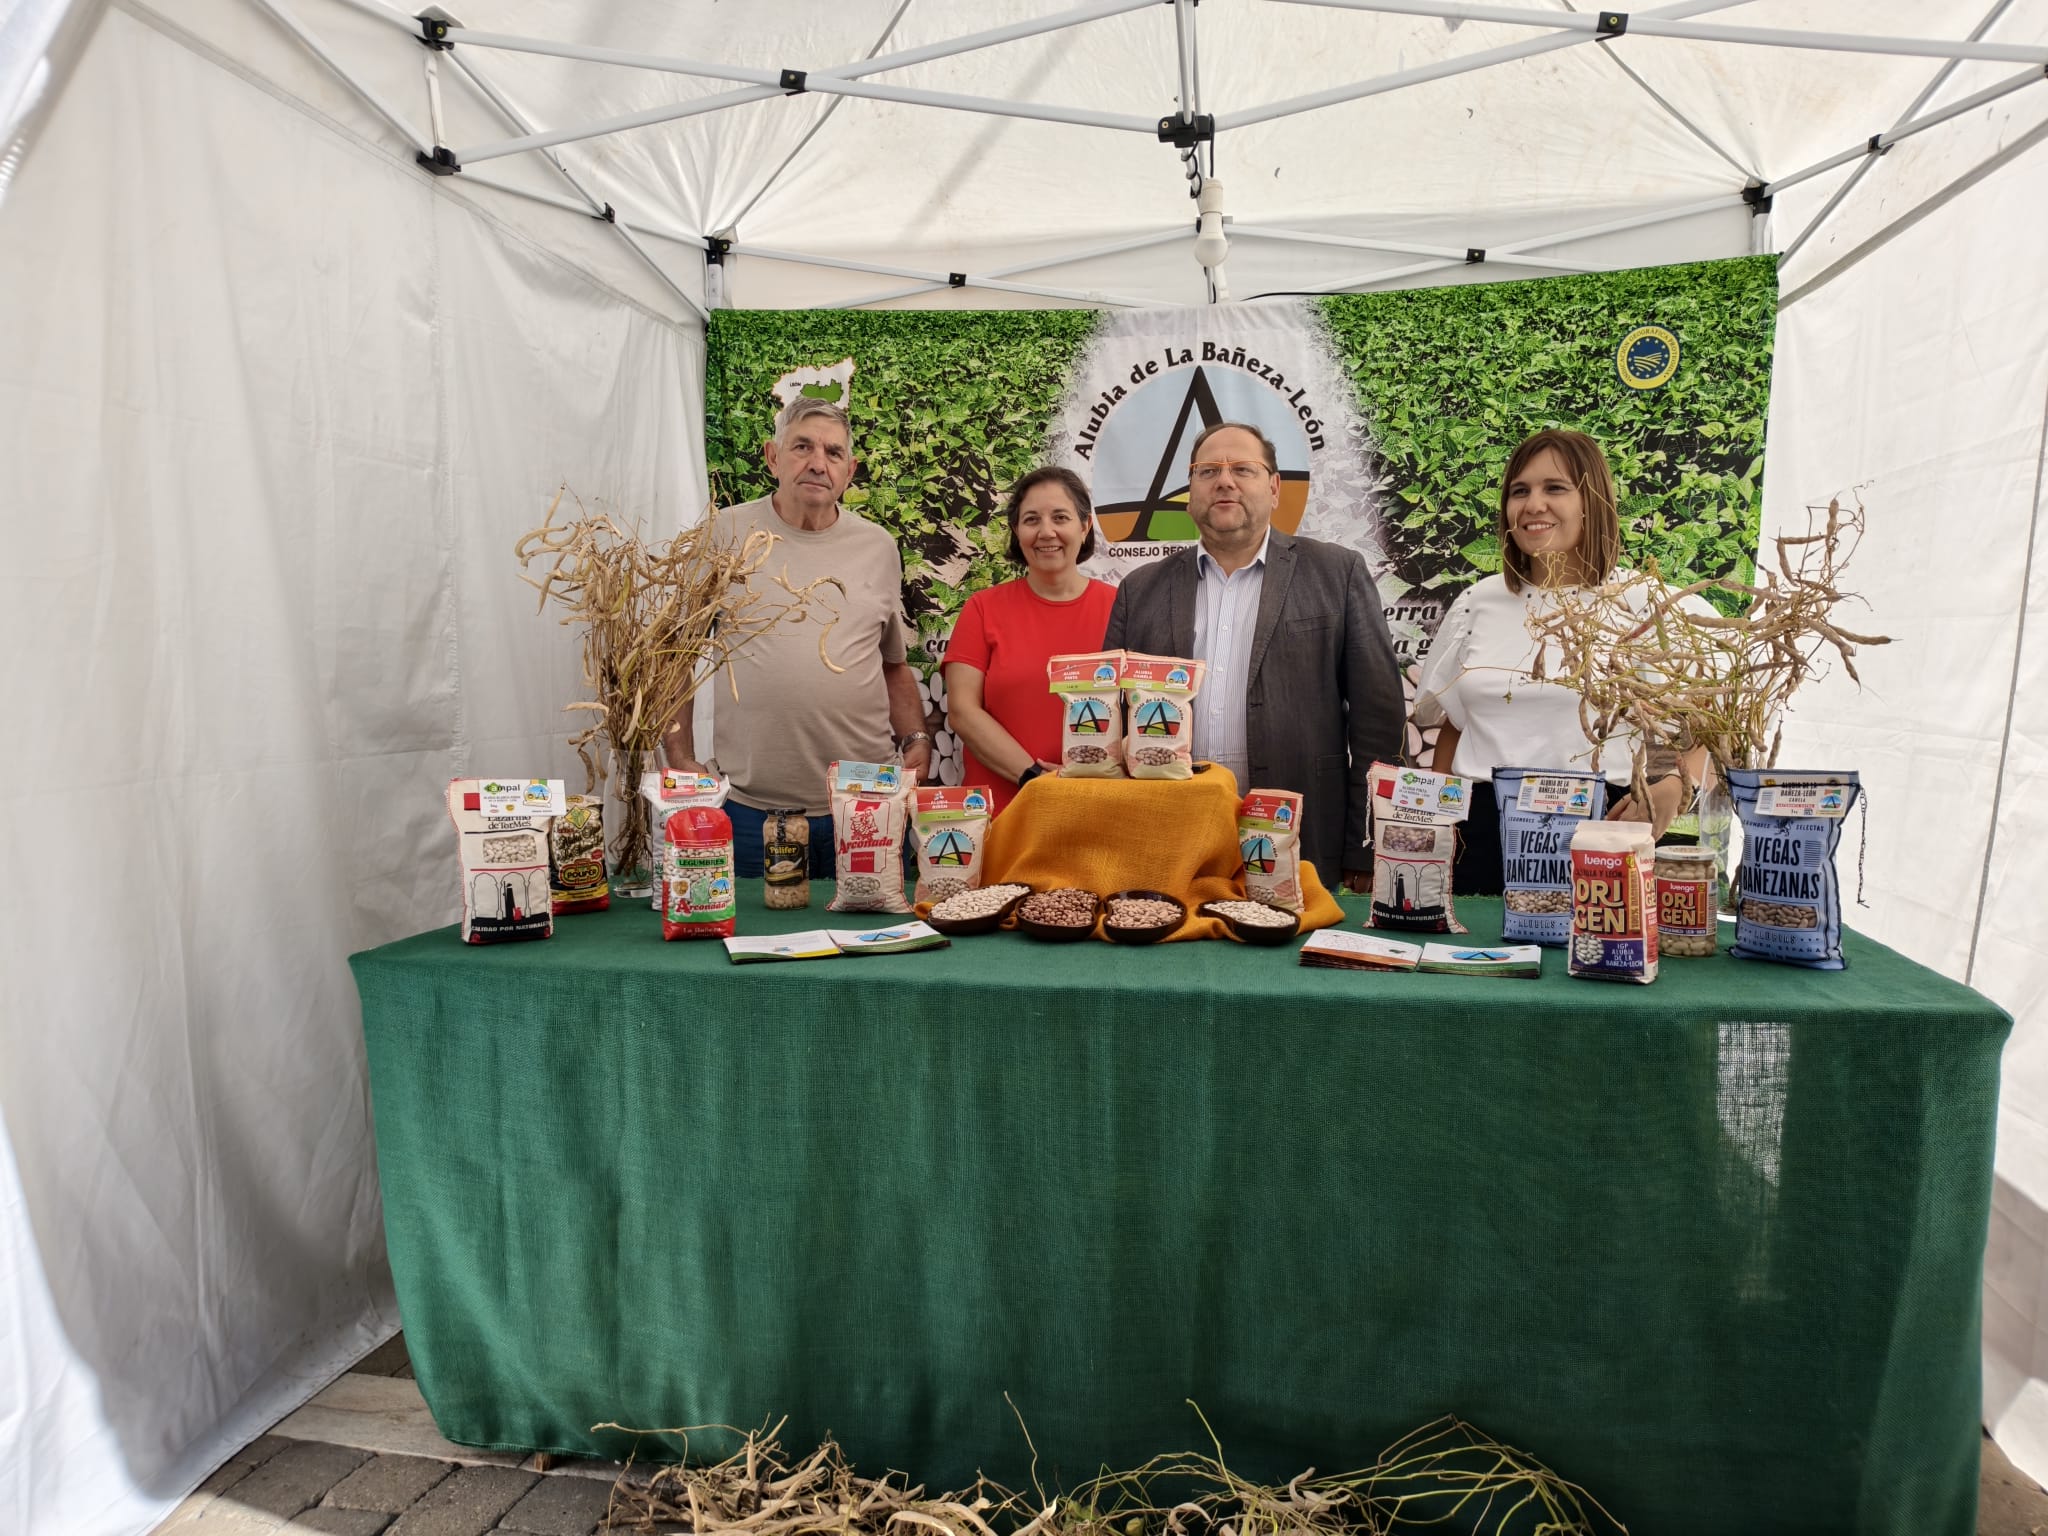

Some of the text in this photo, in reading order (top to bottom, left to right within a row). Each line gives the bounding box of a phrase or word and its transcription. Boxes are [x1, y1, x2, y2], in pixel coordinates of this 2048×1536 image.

[1074, 341, 1325, 461] Alubia de La Bañeza-León
[1108, 547, 1160, 557] CONSEJO
[769, 845, 797, 854] Polifer
[839, 836, 893, 855] Arconada
[1520, 830, 1560, 854] VEGAS
[1755, 836, 1801, 866] VEGAS
[679, 858, 725, 866] LEGUMBRES
[1506, 854, 1572, 884] BAÑEZANAS
[1584, 854, 1622, 869] luengo
[1670, 883, 1695, 893] luengo
[1743, 863, 1820, 899] BAÑEZANAS
[1576, 878, 1624, 907] ORI
[1661, 892, 1696, 910] ORI
[675, 899, 726, 915] Arconada
[1575, 905, 1625, 932] GEN
[1661, 908, 1696, 926] GEN
